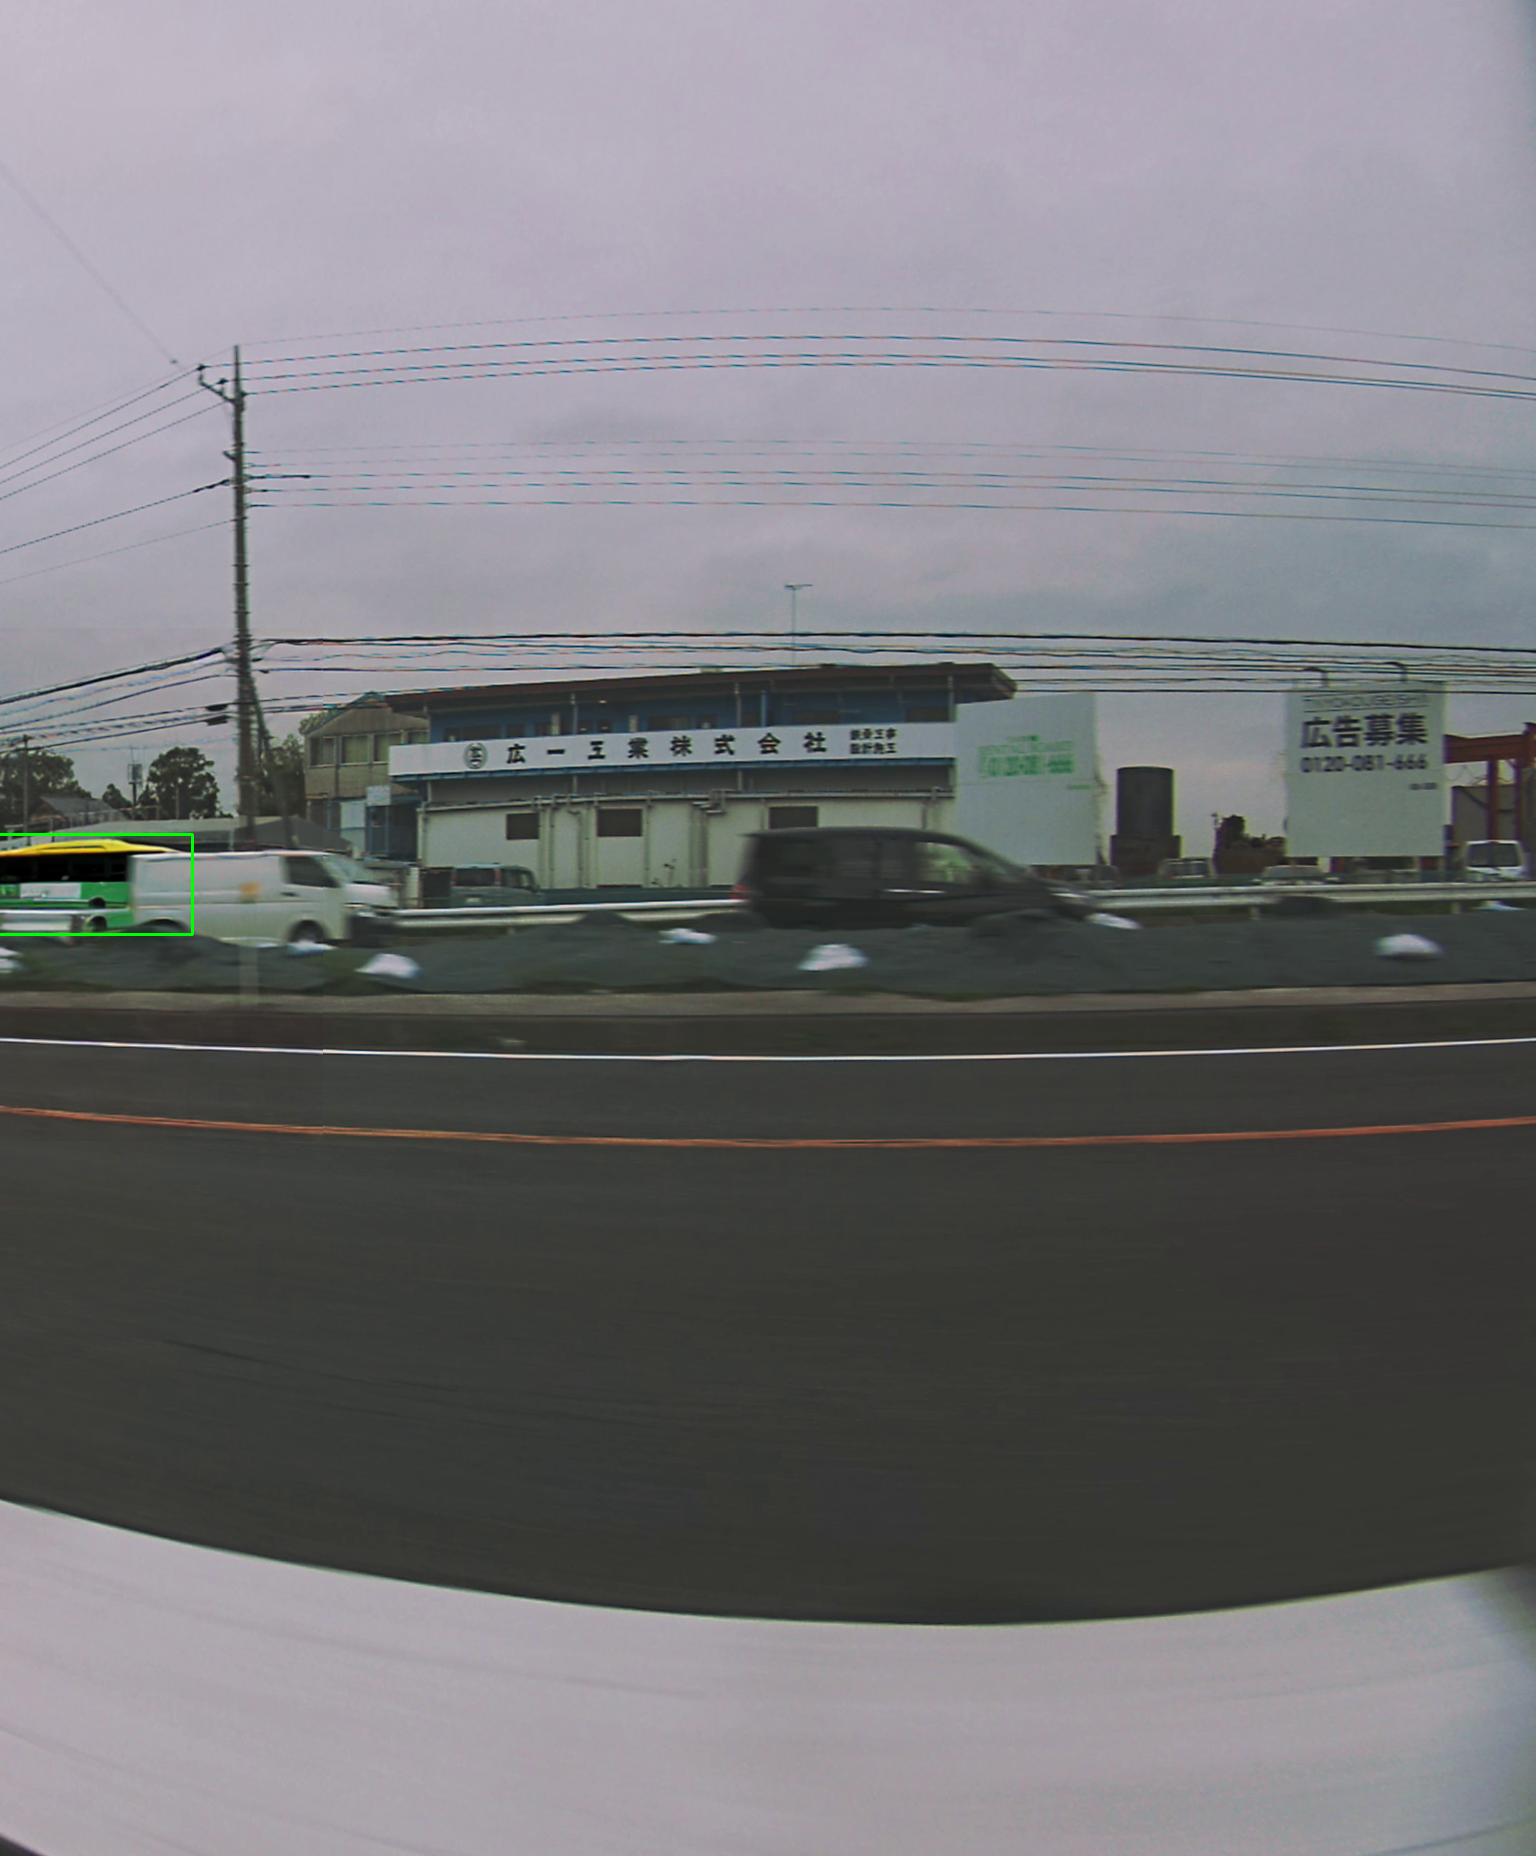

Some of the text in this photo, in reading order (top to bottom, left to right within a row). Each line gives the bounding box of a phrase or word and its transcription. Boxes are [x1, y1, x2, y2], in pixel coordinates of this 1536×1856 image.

[1301, 712, 1428, 748] 広告募集
[506, 731, 827, 764] 広一工業株式会社
[1301, 753, 1428, 773] 0120-081-666
